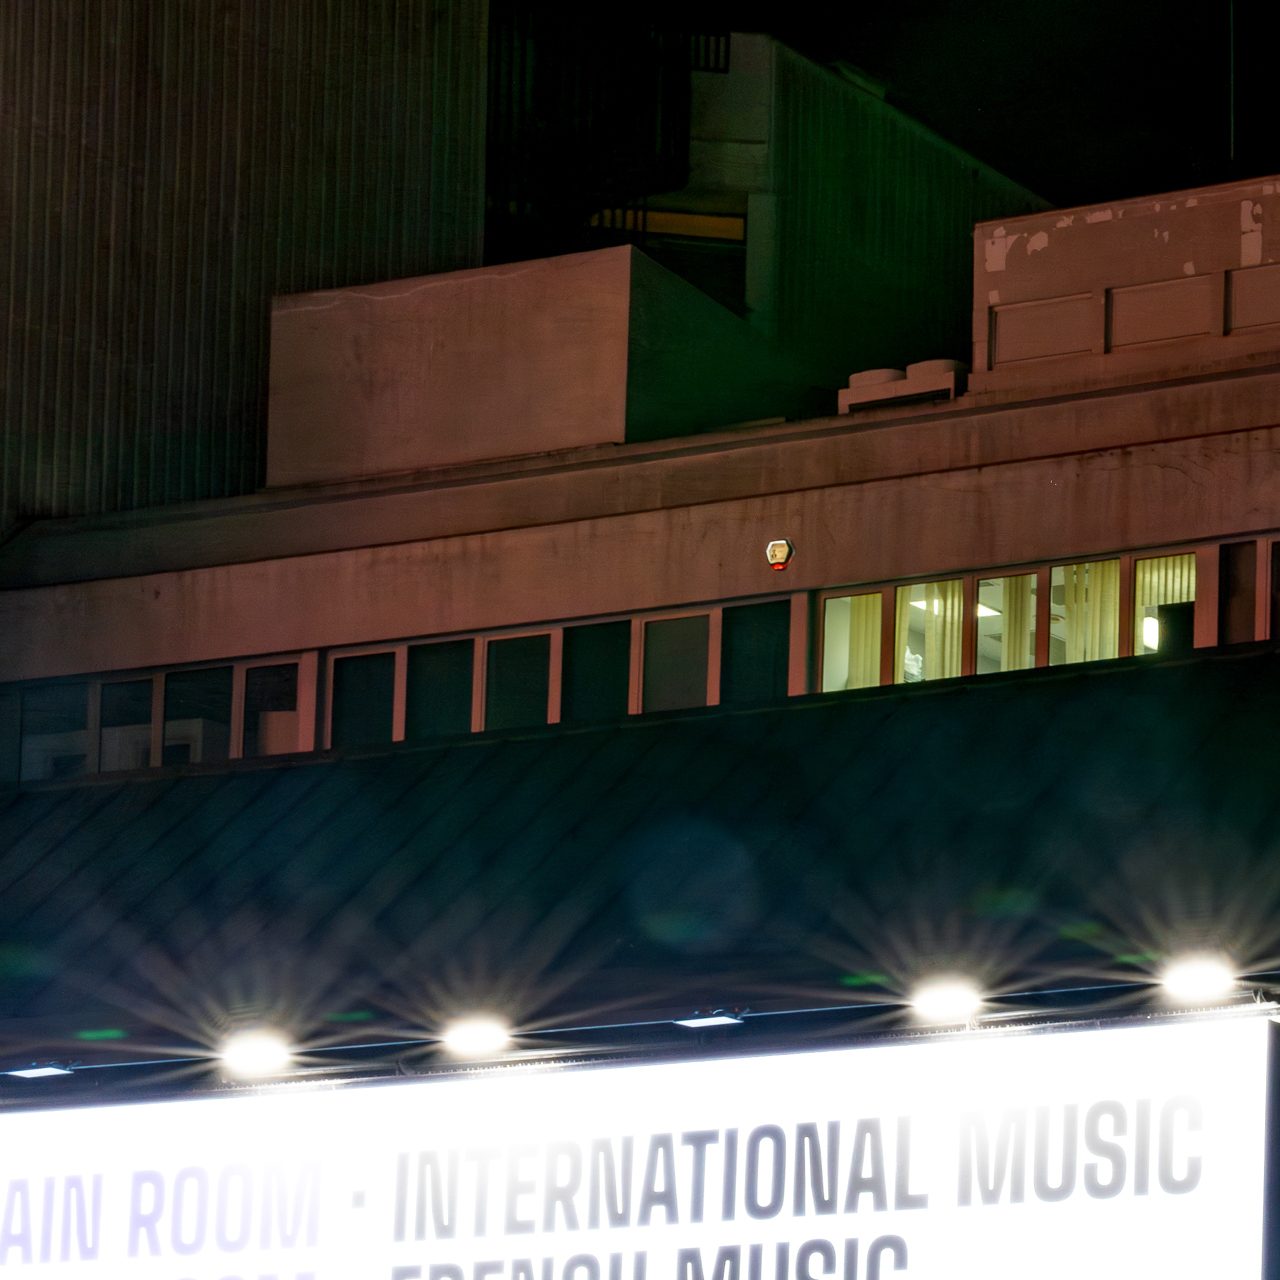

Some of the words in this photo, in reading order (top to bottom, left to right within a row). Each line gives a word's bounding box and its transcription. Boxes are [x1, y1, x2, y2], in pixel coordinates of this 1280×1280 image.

[127, 1160, 321, 1258] ROOM
[391, 1115, 929, 1243] INTERNATIONAL
[956, 1094, 1204, 1208] MUSIC
